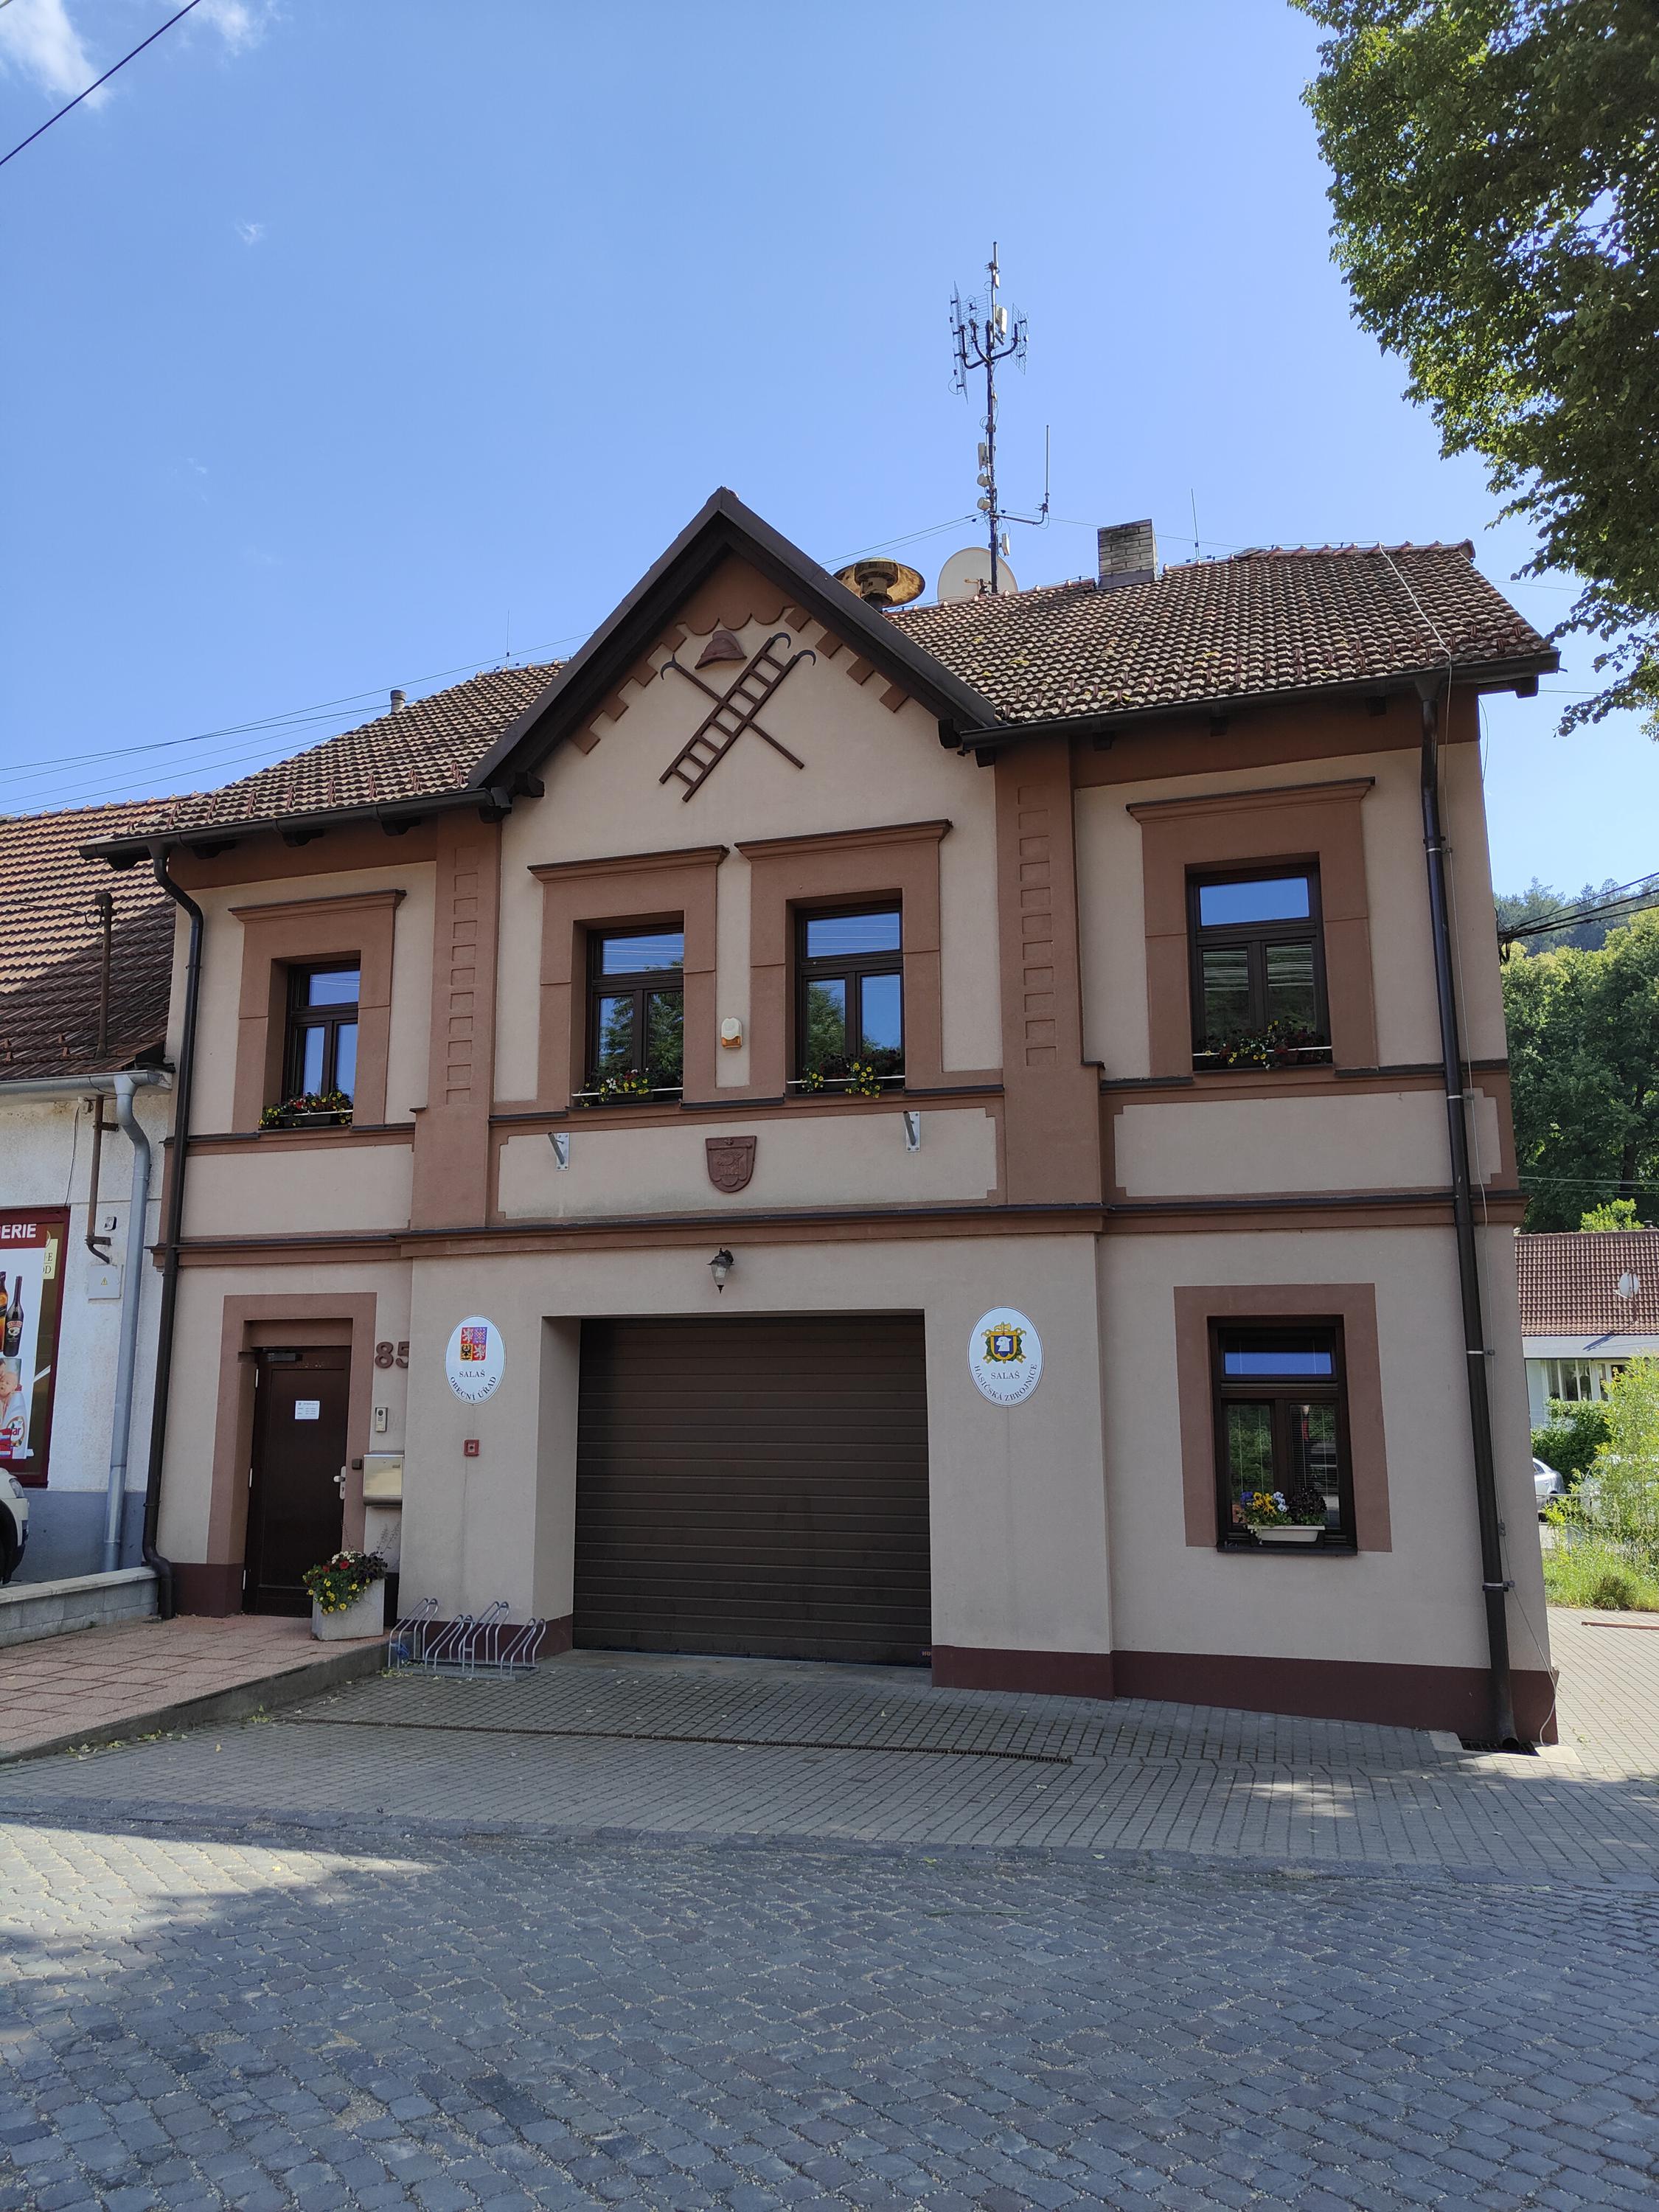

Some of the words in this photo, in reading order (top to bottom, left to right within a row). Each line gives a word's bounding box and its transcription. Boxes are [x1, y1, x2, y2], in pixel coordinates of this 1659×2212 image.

[0, 1223, 37, 1239] ERIE
[375, 1341, 409, 1368] 85
[459, 1369, 485, 1378] SALAŠ
[974, 1365, 1003, 1401] HASIČSKÁ
[1004, 1363, 1037, 1401] ZBROJNICE
[991, 1371, 1020, 1380] SALAŠ
[450, 1377, 476, 1400] OBECNÍ
[477, 1377, 496, 1398] ÚŘAD
